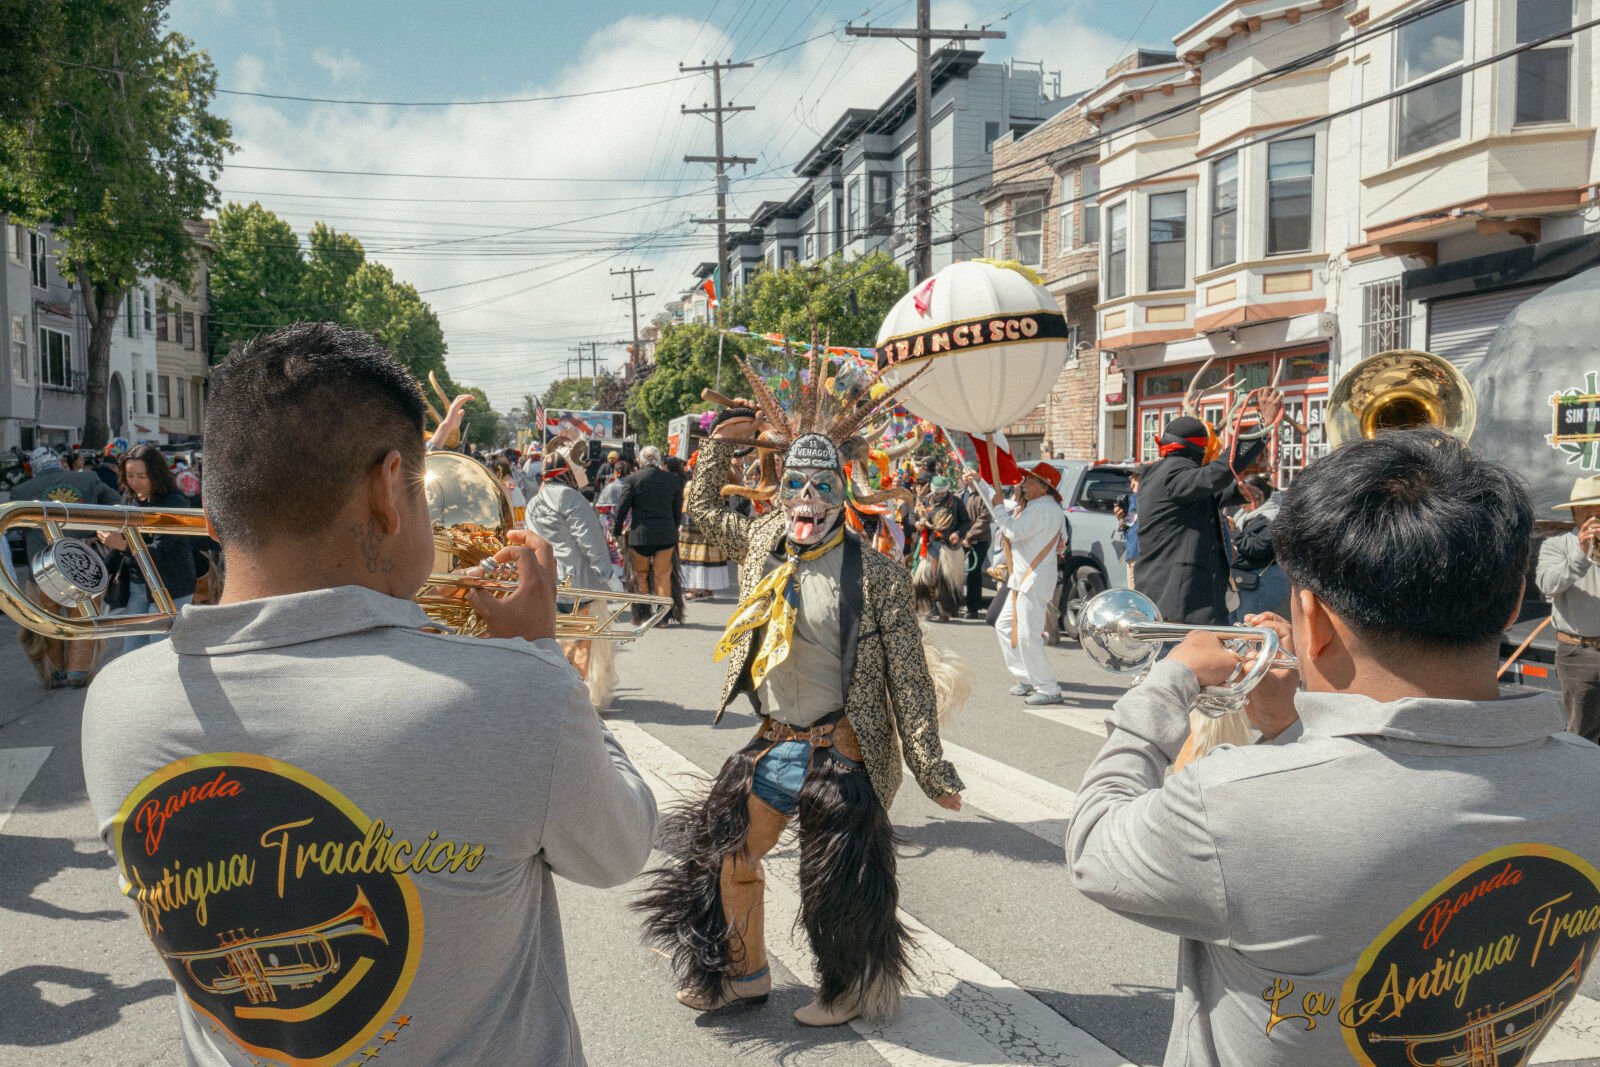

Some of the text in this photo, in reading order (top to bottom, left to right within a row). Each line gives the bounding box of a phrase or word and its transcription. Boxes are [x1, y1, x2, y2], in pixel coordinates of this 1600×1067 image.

[797, 447, 829, 457] VENADO
[1565, 408, 1584, 423] SIN
[135, 771, 243, 856] Banda
[260, 817, 487, 898] Tradicion
[1418, 862, 1524, 949] Banda
[1262, 977, 1336, 1037] La
[1338, 933, 1520, 1029] Antigua
